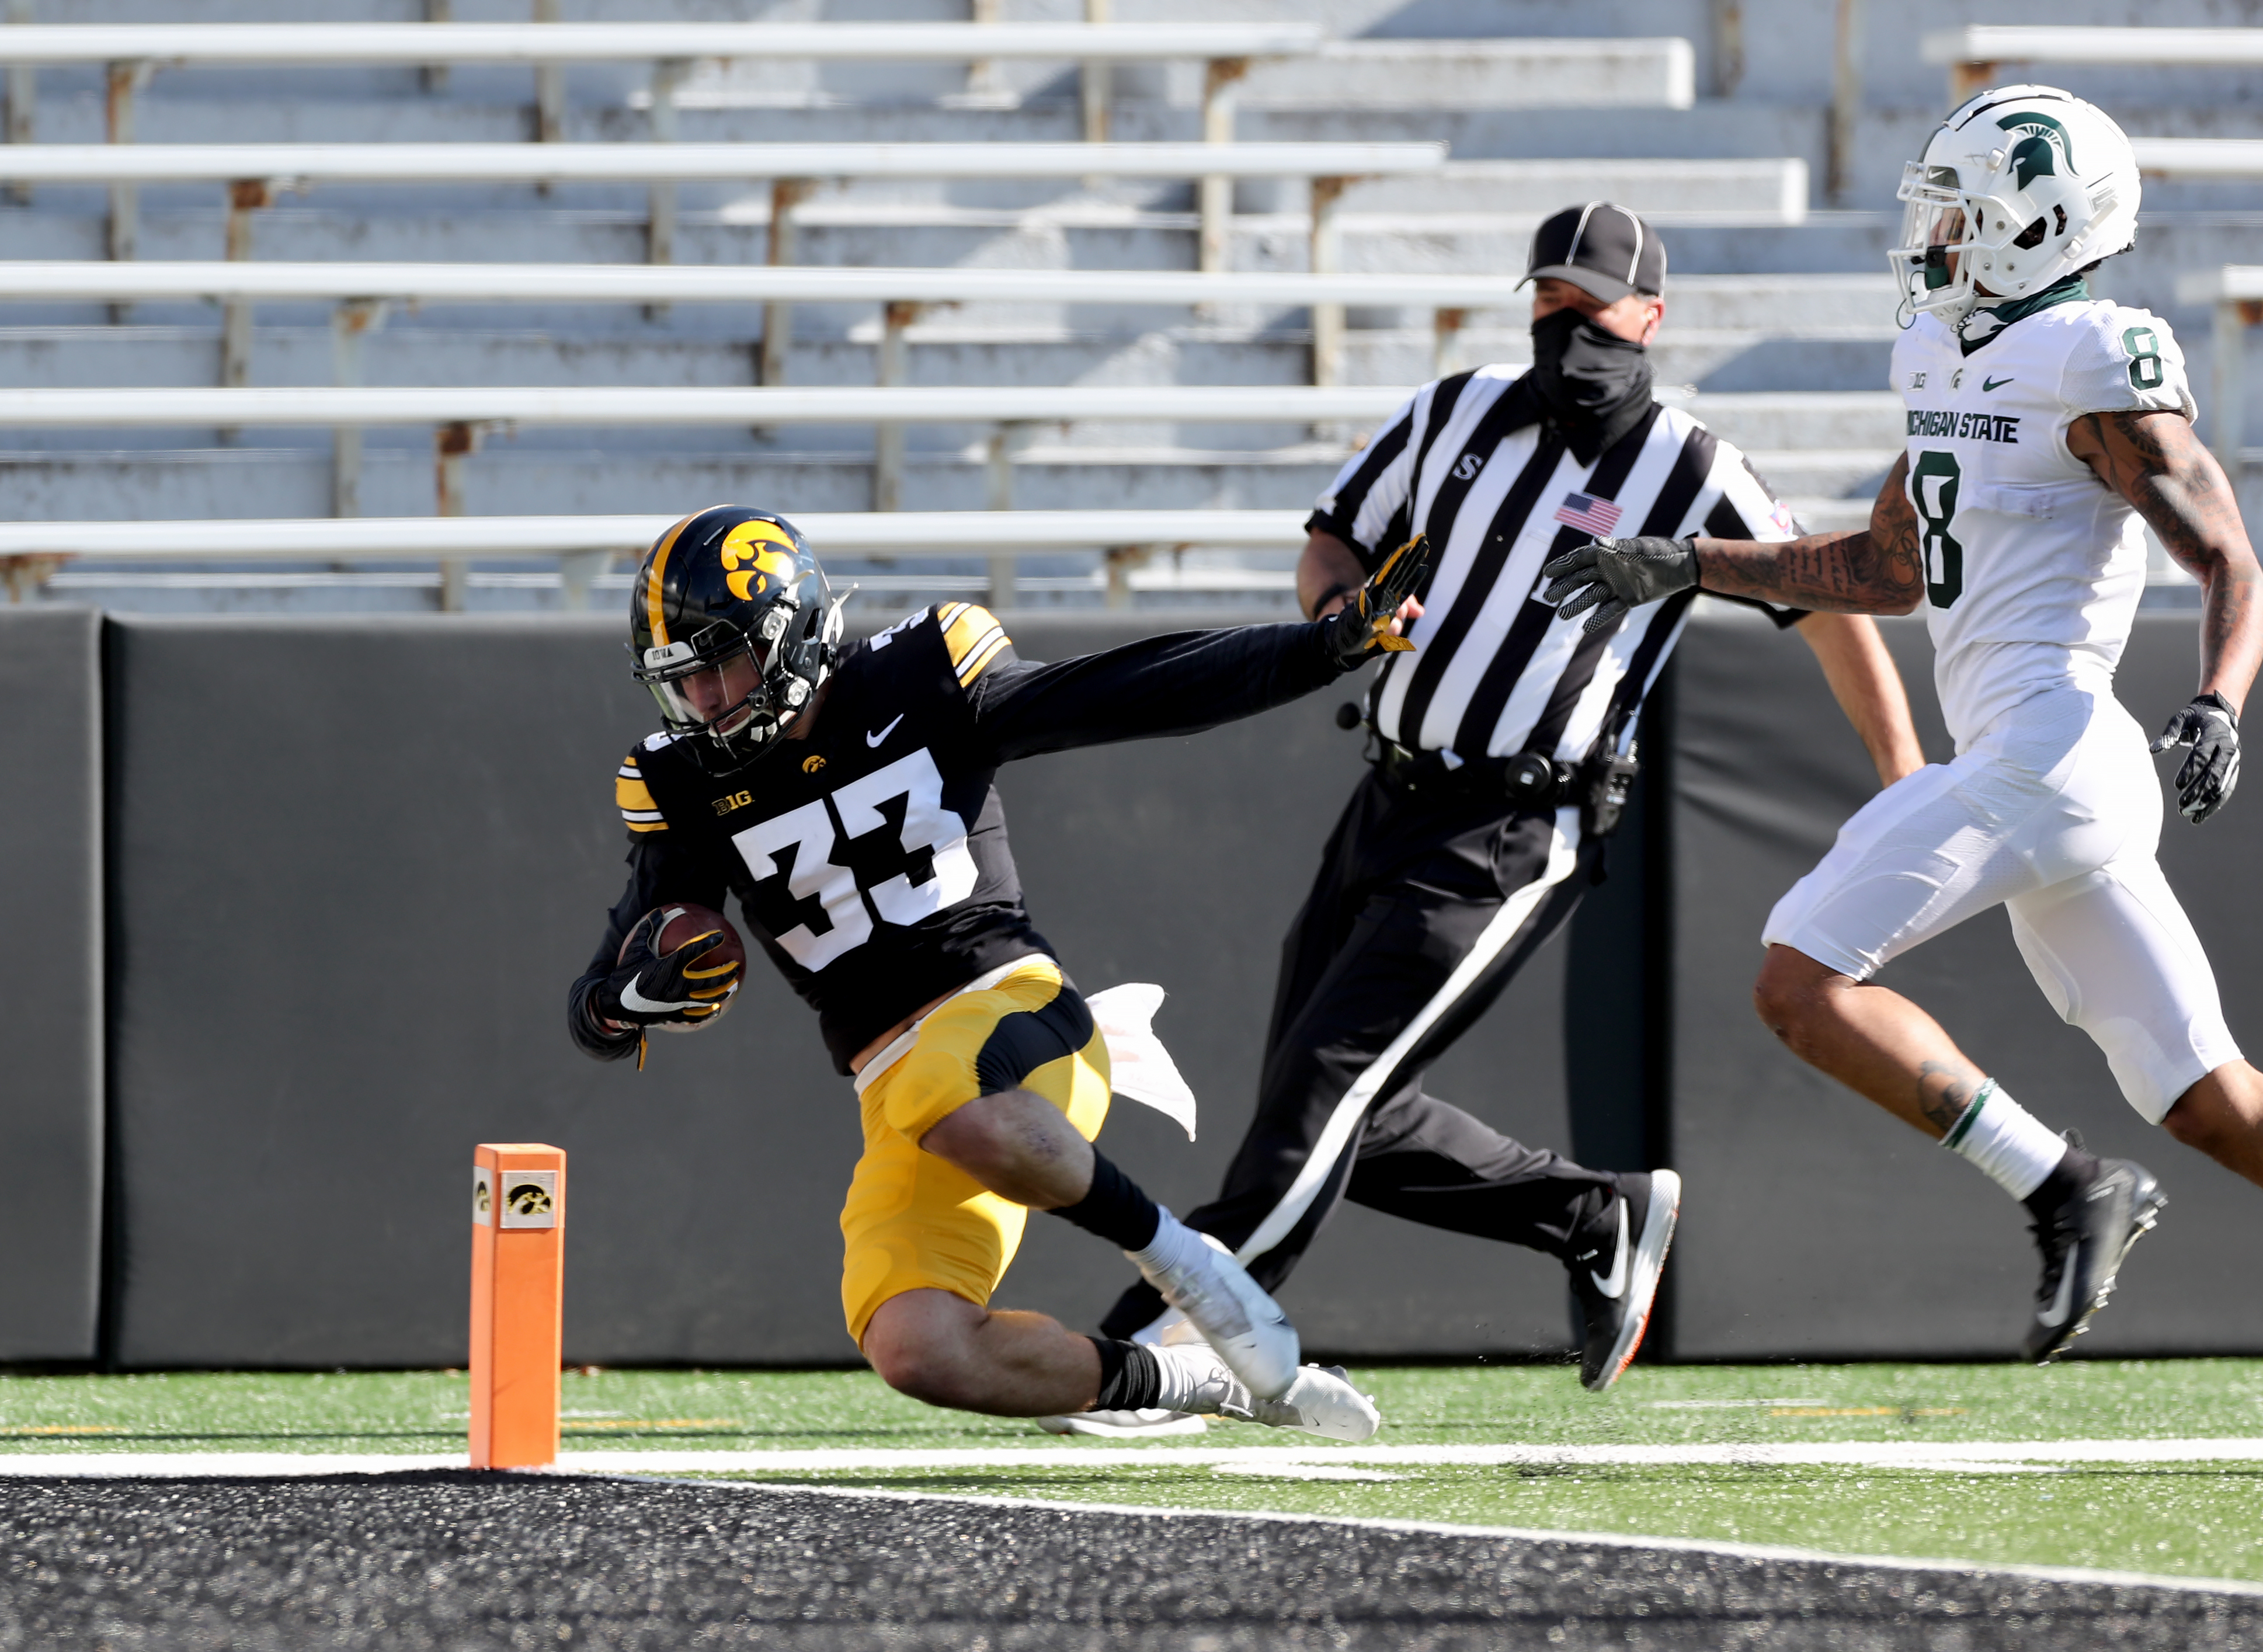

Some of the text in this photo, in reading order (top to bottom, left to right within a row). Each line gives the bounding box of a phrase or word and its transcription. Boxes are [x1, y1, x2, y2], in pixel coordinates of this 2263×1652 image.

[2121, 326, 2164, 391] 8
[1907, 410, 2021, 443] ICHIGAN STATE
[1452, 453, 1483, 481] S
[1912, 450, 1963, 609] 8
[652, 646, 674, 660] IOWA
[731, 746, 980, 972] 33
